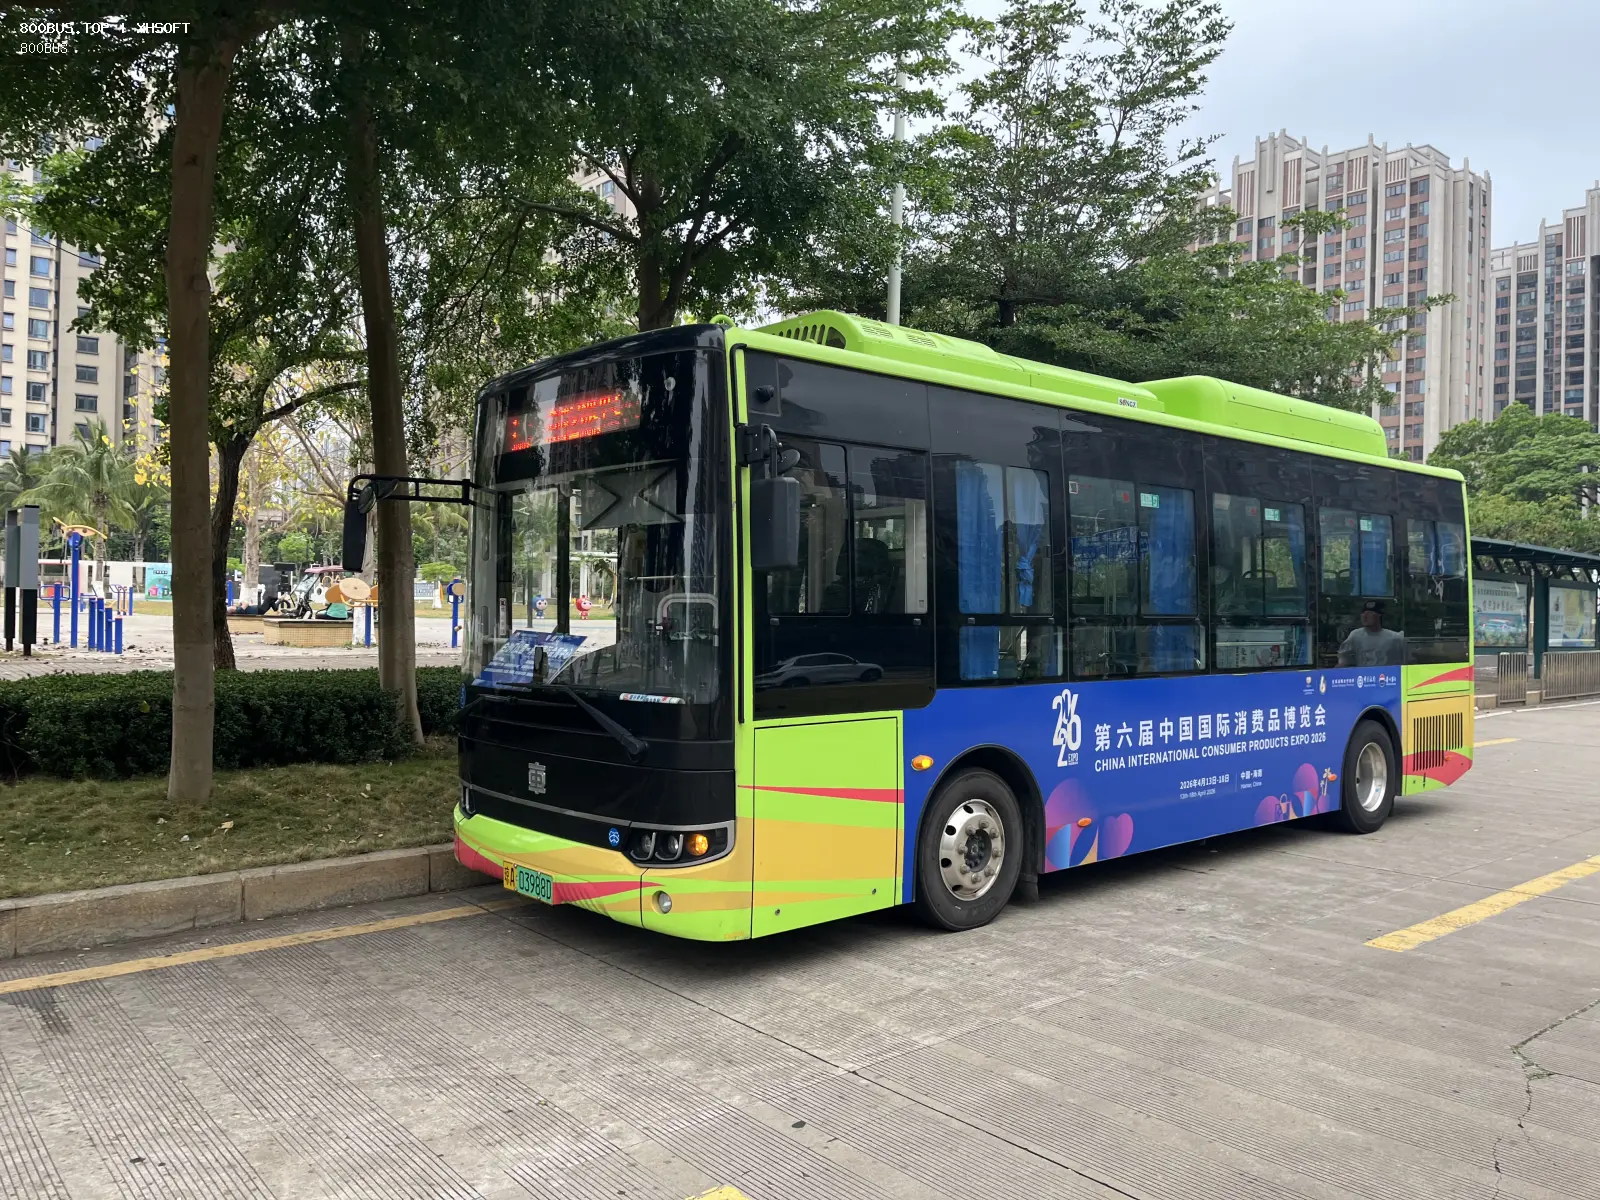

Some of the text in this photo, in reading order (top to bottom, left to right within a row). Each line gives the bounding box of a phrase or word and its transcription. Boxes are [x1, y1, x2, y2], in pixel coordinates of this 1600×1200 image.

[1094, 703, 1326, 752] 第六届中国国际消费品博览会
[1094, 731, 1327, 772] CHINA INTERNATIONAL CONSUMER PRODUCTS EXPO 2026
